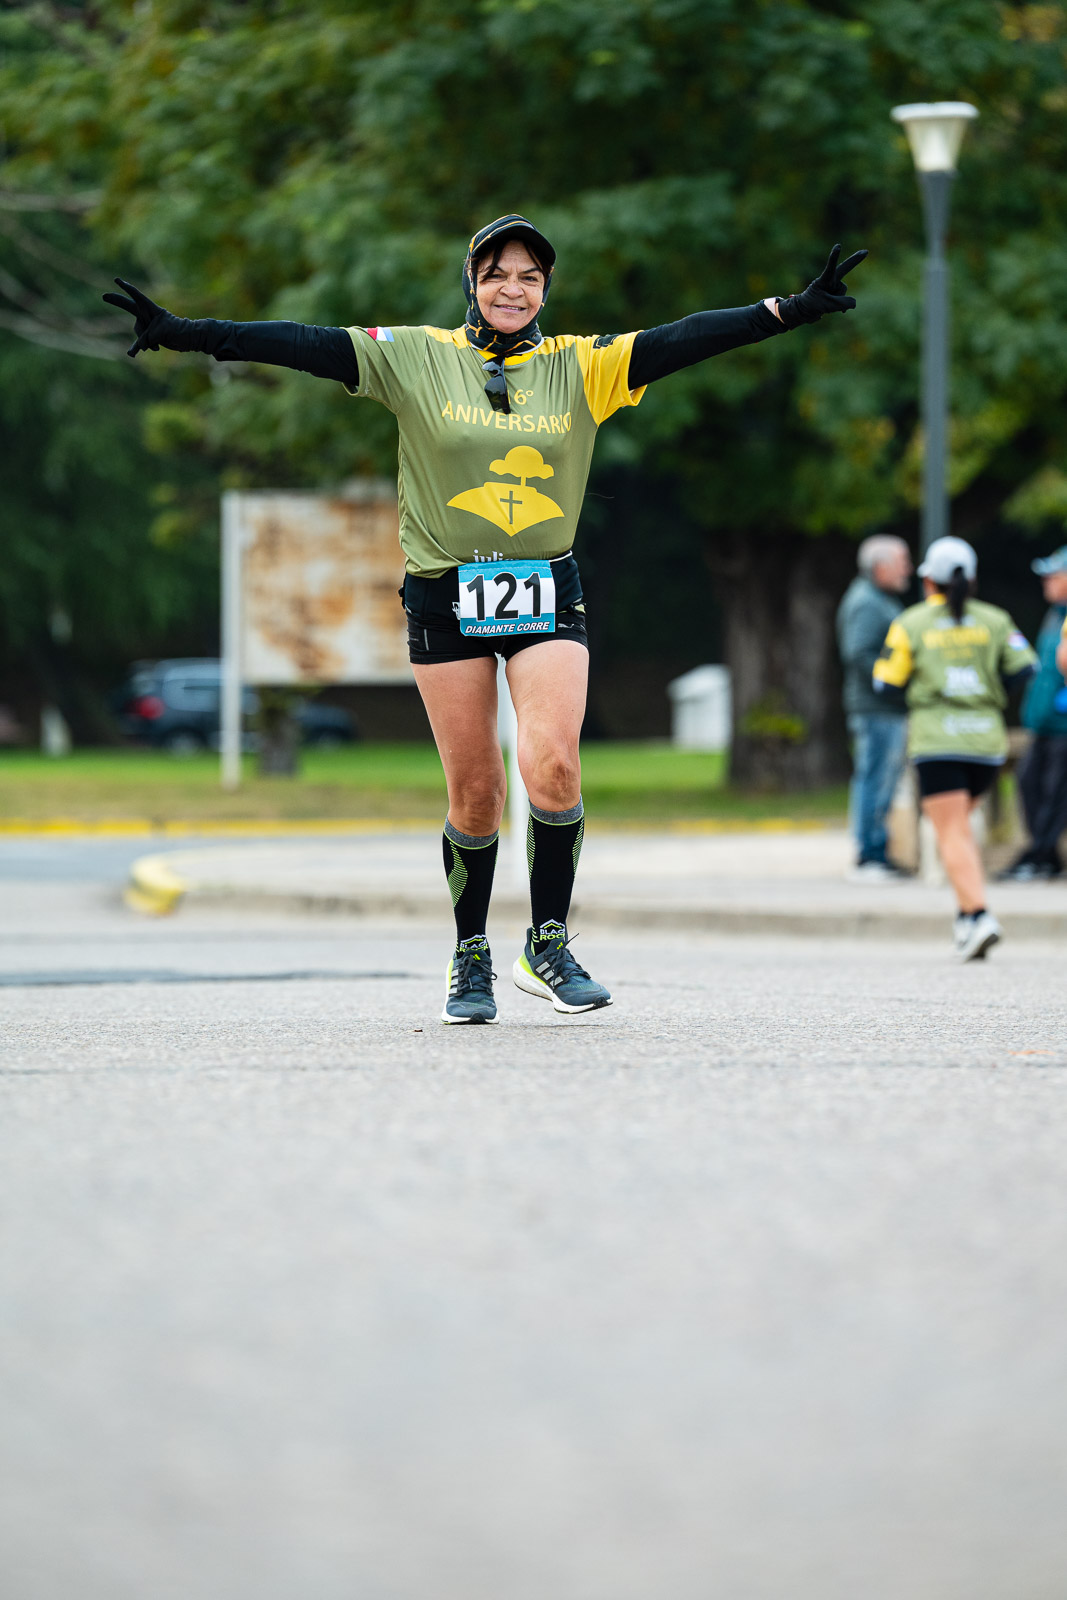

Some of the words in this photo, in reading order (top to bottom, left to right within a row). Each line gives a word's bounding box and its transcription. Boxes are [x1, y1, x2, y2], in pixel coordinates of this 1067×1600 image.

[441, 400, 572, 434] ANIVERSARIO
[466, 571, 541, 621] 121
[465, 623, 516, 635] DIAMANTE
[516, 621, 550, 632] CORRE
